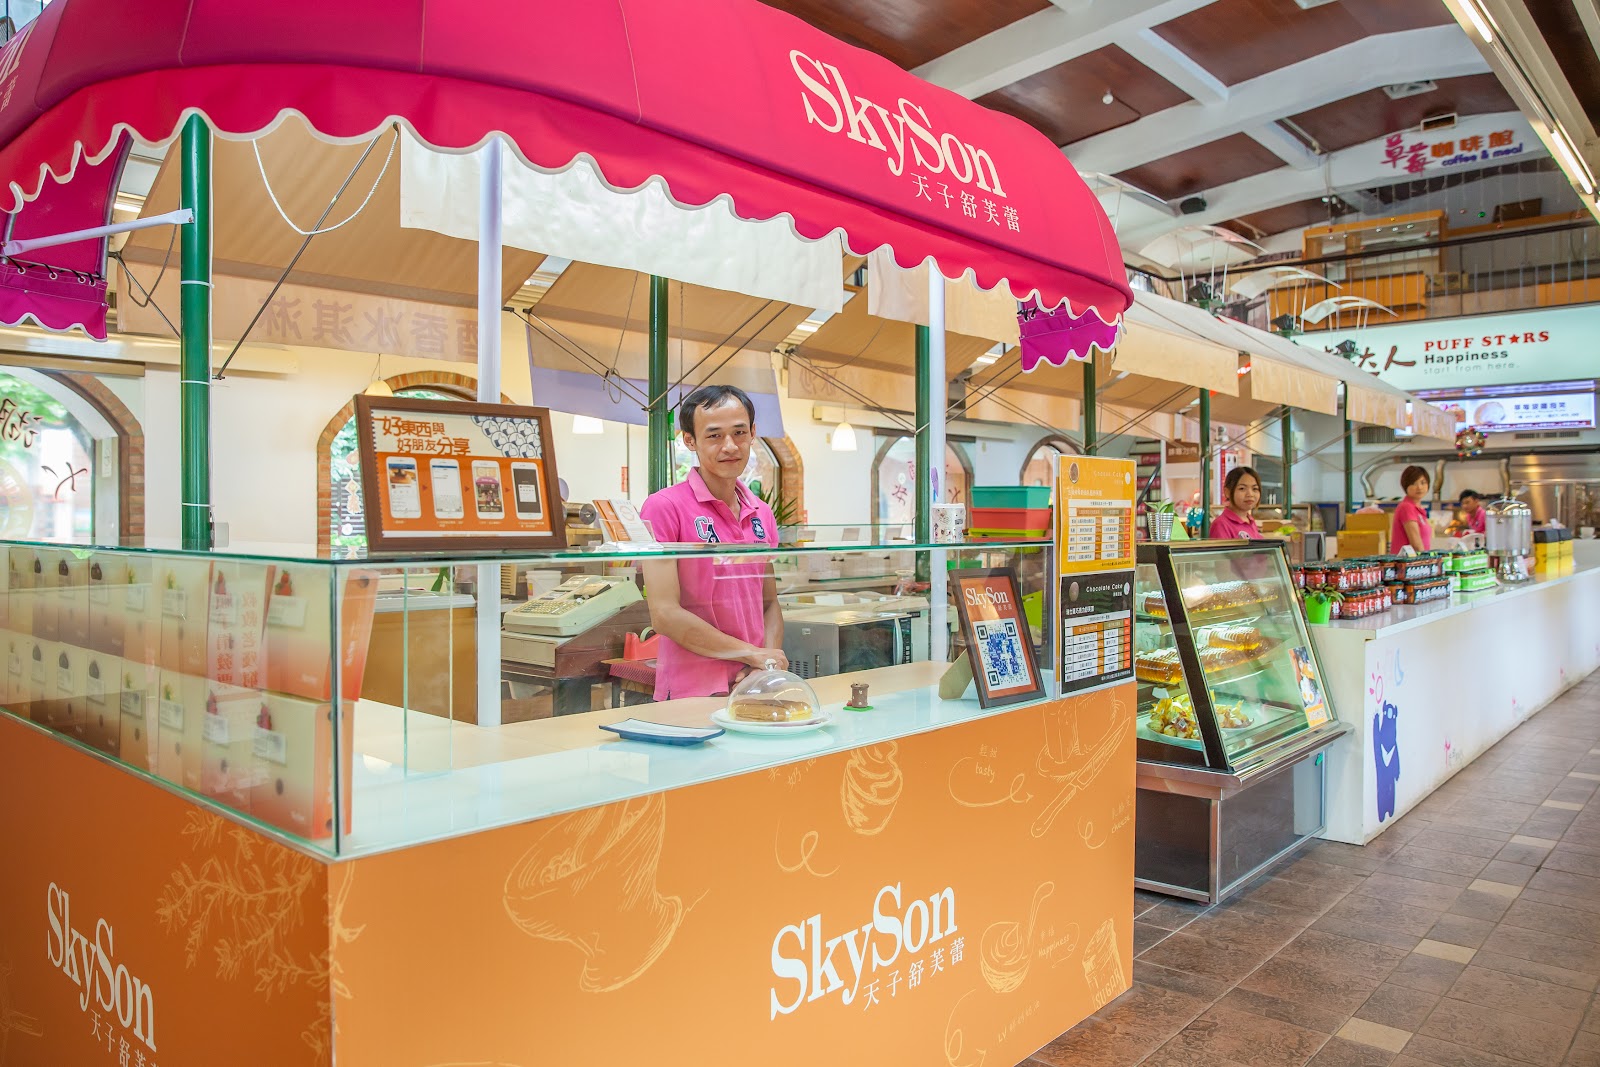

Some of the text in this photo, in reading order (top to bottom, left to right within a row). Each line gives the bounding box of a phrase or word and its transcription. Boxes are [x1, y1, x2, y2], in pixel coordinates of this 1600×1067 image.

[789, 49, 1008, 199] SkySon
[1442, 142, 1523, 166] coffee & meal
[910, 172, 1021, 233] 天子舒芙蕾
[1424, 337, 1474, 352] PUFF
[1424, 350, 1508, 365] Happiness
[1424, 366, 1450, 375] start
[1455, 364, 1482, 373] from
[374, 415, 446, 438] 好東西與
[397, 436, 471, 456] 好朋友分享
[965, 587, 1010, 609] SkySon
[1085, 584, 1111, 593] Chocolate
[976, 761, 996, 784] tasty
[770, 881, 958, 1021] SkySon
[1038, 934, 1070, 960] Happiness
[47, 881, 157, 1053] SkySon
[863, 936, 965, 1012] 天子舒芙蕾
[91, 1008, 160, 1067] 天子舒芙
